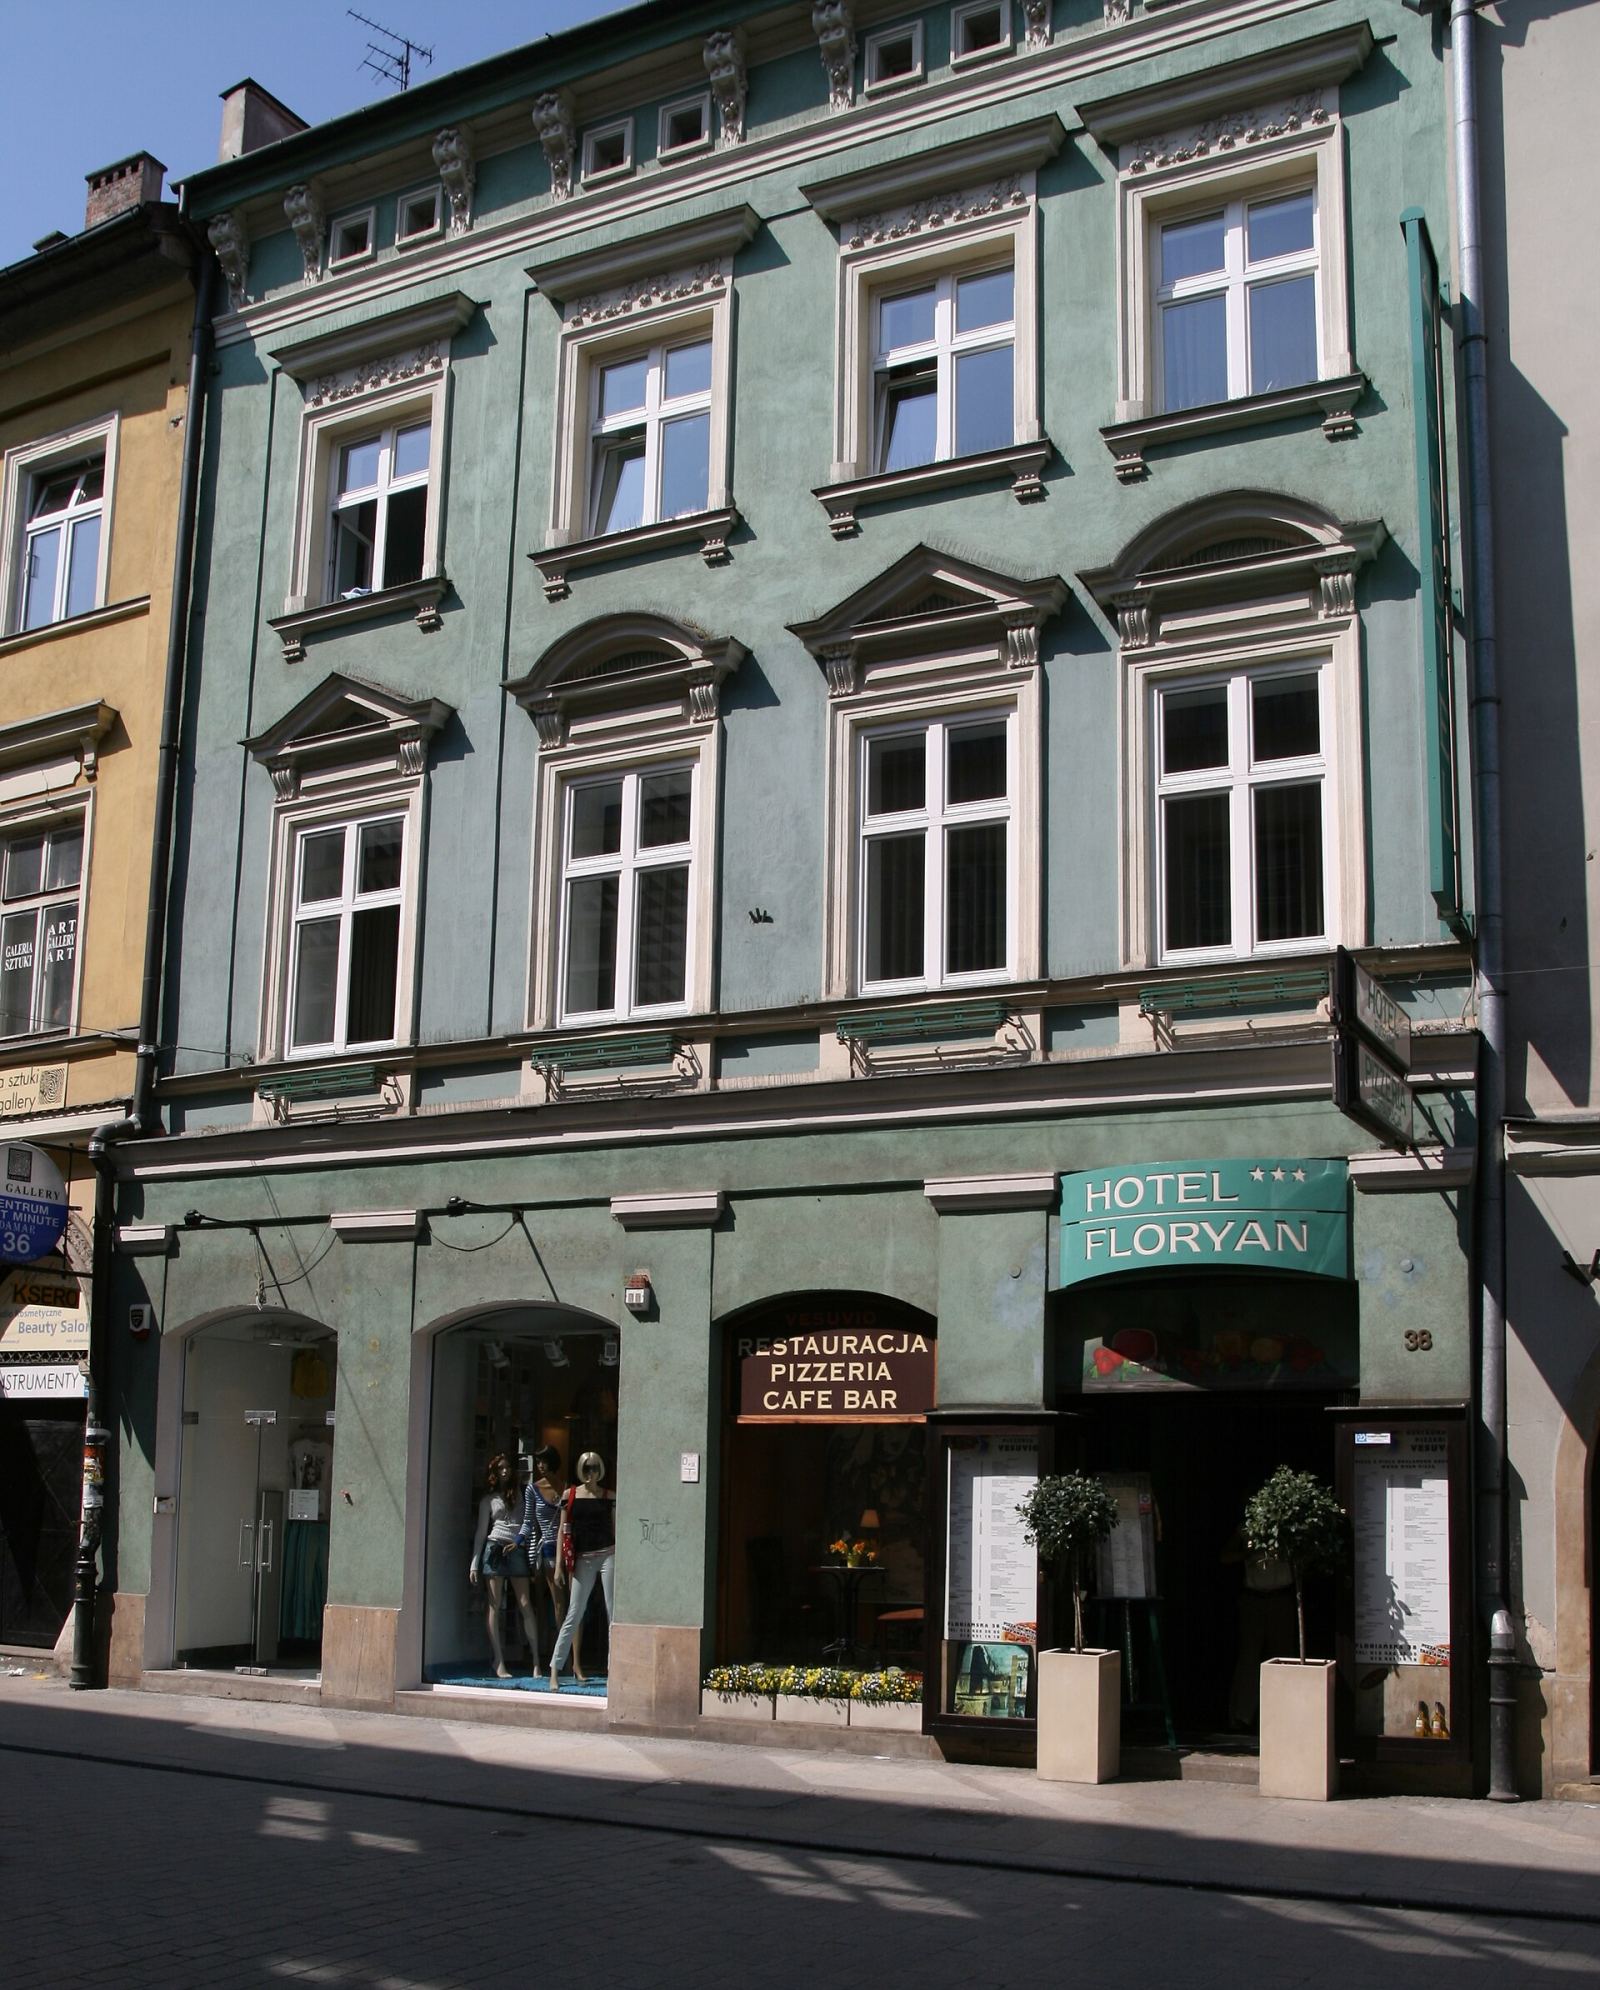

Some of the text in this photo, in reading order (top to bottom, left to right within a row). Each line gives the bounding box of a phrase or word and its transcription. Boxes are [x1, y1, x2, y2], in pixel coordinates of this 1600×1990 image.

[48, 920, 76, 935] ART
[5, 942, 33, 958] GALERIA
[47, 947, 74, 963] ART
[4, 955, 33, 971] SZTUKI
[1368, 979, 1399, 1039] HOTEL
[8, 1067, 39, 1087] sztuki
[1365, 1054, 1407, 1116] PIZZERIA
[5, 1183, 60, 1200] GALLERY
[1085, 1170, 1239, 1213] HOTEL
[13, 1212, 59, 1227] MINUTE
[3, 1232, 30, 1254] 36
[1084, 1219, 1307, 1260] FLORYAN
[13, 1283, 77, 1307] KSERO
[18, 1321, 57, 1336] Beauty
[785, 1311, 877, 1327] VESUVIO
[737, 1334, 928, 1356] RESTAURACJA
[1404, 1329, 1433, 1352] 38
[770, 1361, 892, 1382] PIZZERIA
[763, 1389, 897, 1410] CAFE BAR
